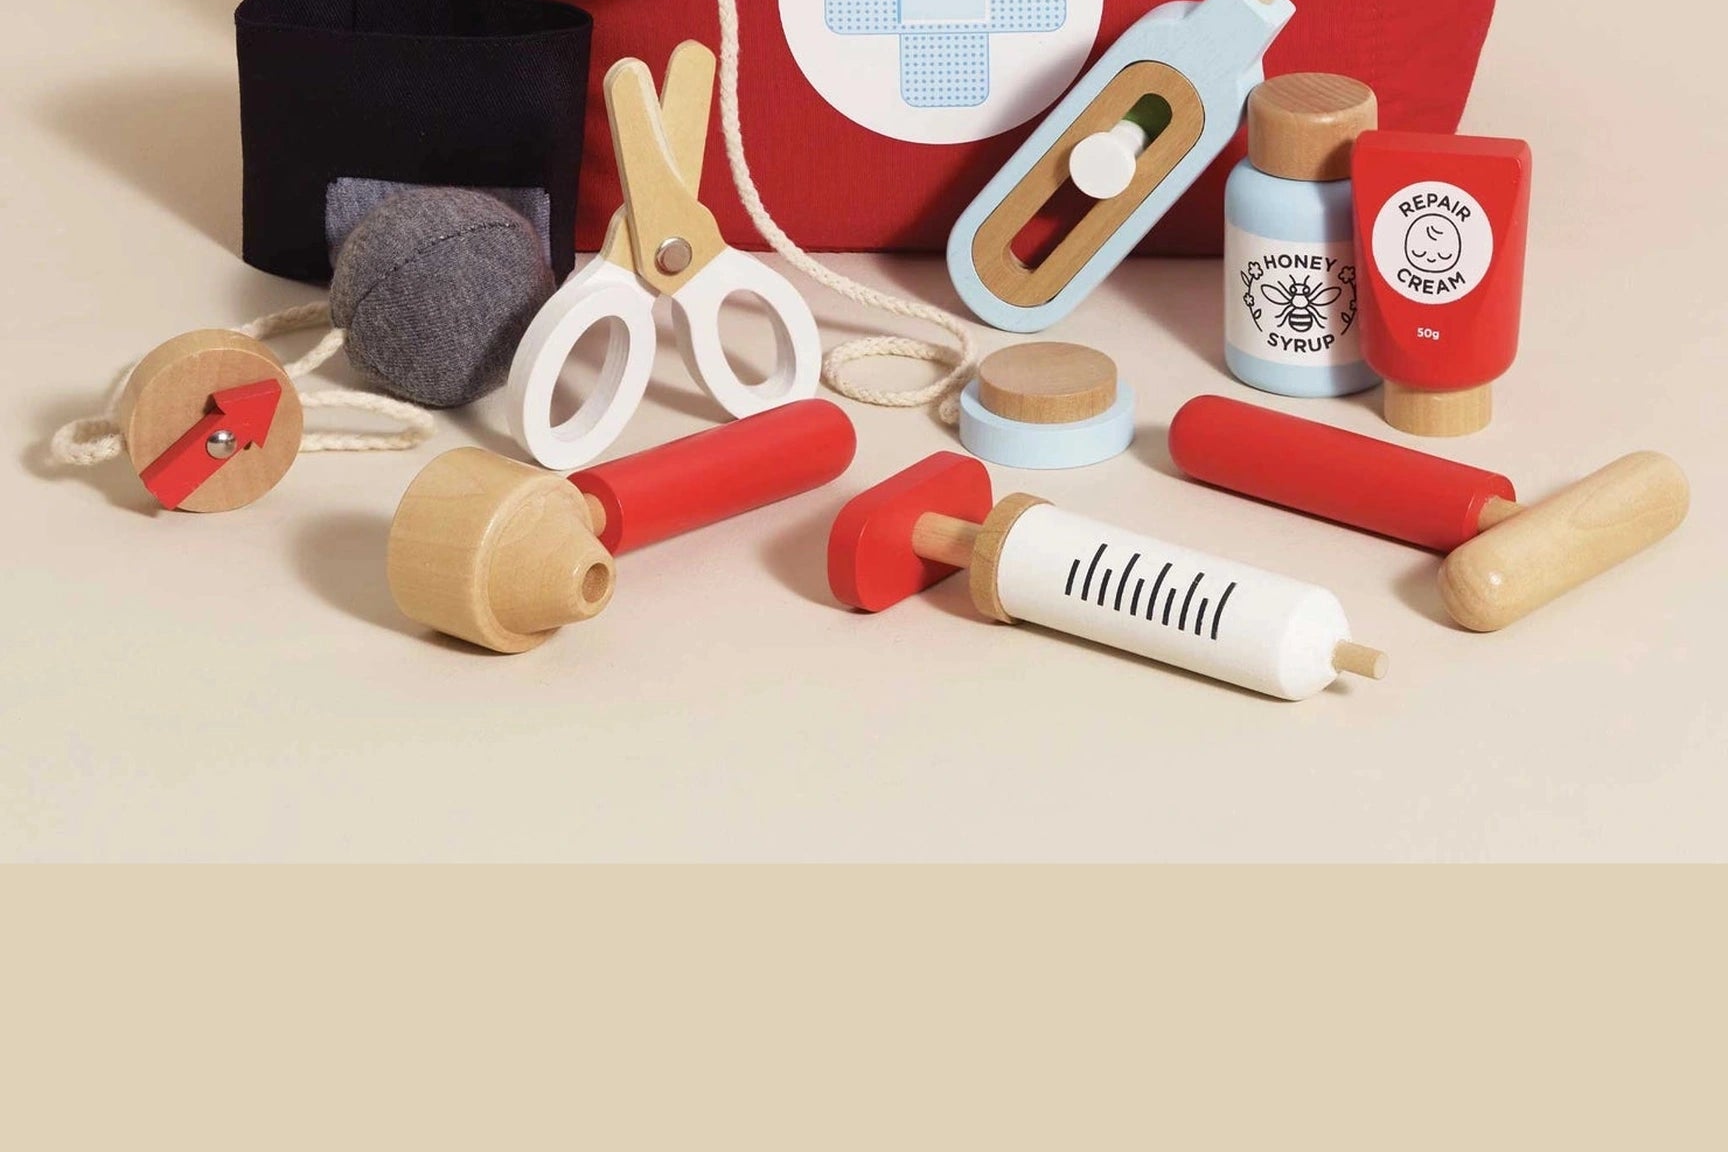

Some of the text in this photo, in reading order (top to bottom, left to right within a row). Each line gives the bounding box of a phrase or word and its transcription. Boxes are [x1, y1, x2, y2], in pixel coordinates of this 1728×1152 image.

[1398, 193, 1472, 222] REPAIR
[1263, 254, 1337, 272] HONEY
[1397, 268, 1466, 295] CREAM
[1267, 332, 1335, 353] SYRUP
[1417, 328, 1440, 340] 50g
